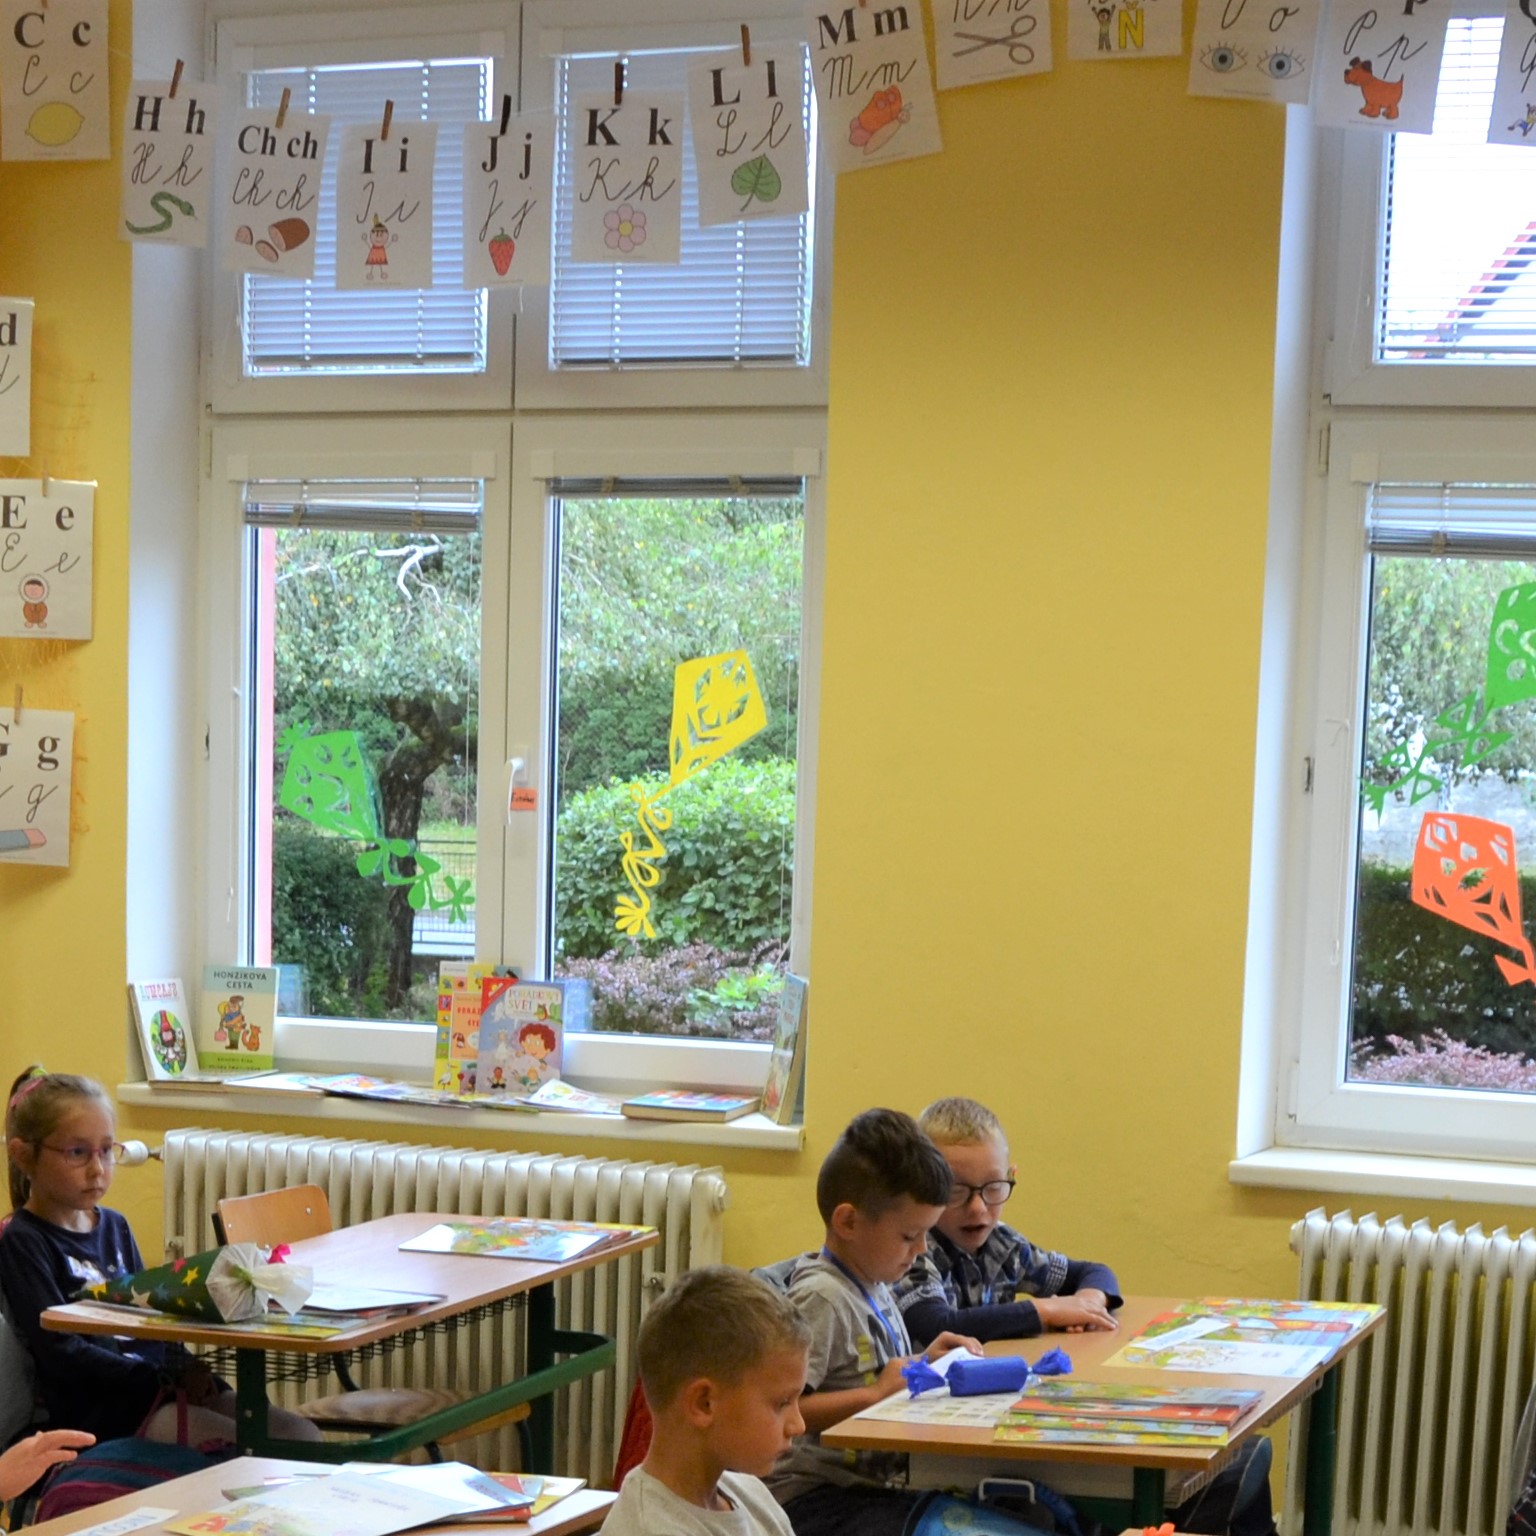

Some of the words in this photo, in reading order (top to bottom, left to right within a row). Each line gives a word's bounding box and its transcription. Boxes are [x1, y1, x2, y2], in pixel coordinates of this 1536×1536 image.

[14, 12, 44, 48] C
[72, 21, 91, 47] c
[817, 7, 860, 50] M
[873, 4, 910, 37] m
[710, 67, 741, 107] L
[766, 60, 779, 98] l
[133, 96, 162, 131] H
[185, 100, 206, 134] h
[585, 108, 621, 146] K
[648, 107, 673, 146] k
[238, 125, 276, 156] Ch
[287, 131, 319, 159] ch
[362, 139, 375, 174] I
[398, 137, 409, 172] i
[481, 135, 500, 173] J
[519, 132, 532, 180] j
[56, 505, 74, 531] e
[37, 736, 60, 771] g
[226, 981, 253, 989] CESTA
